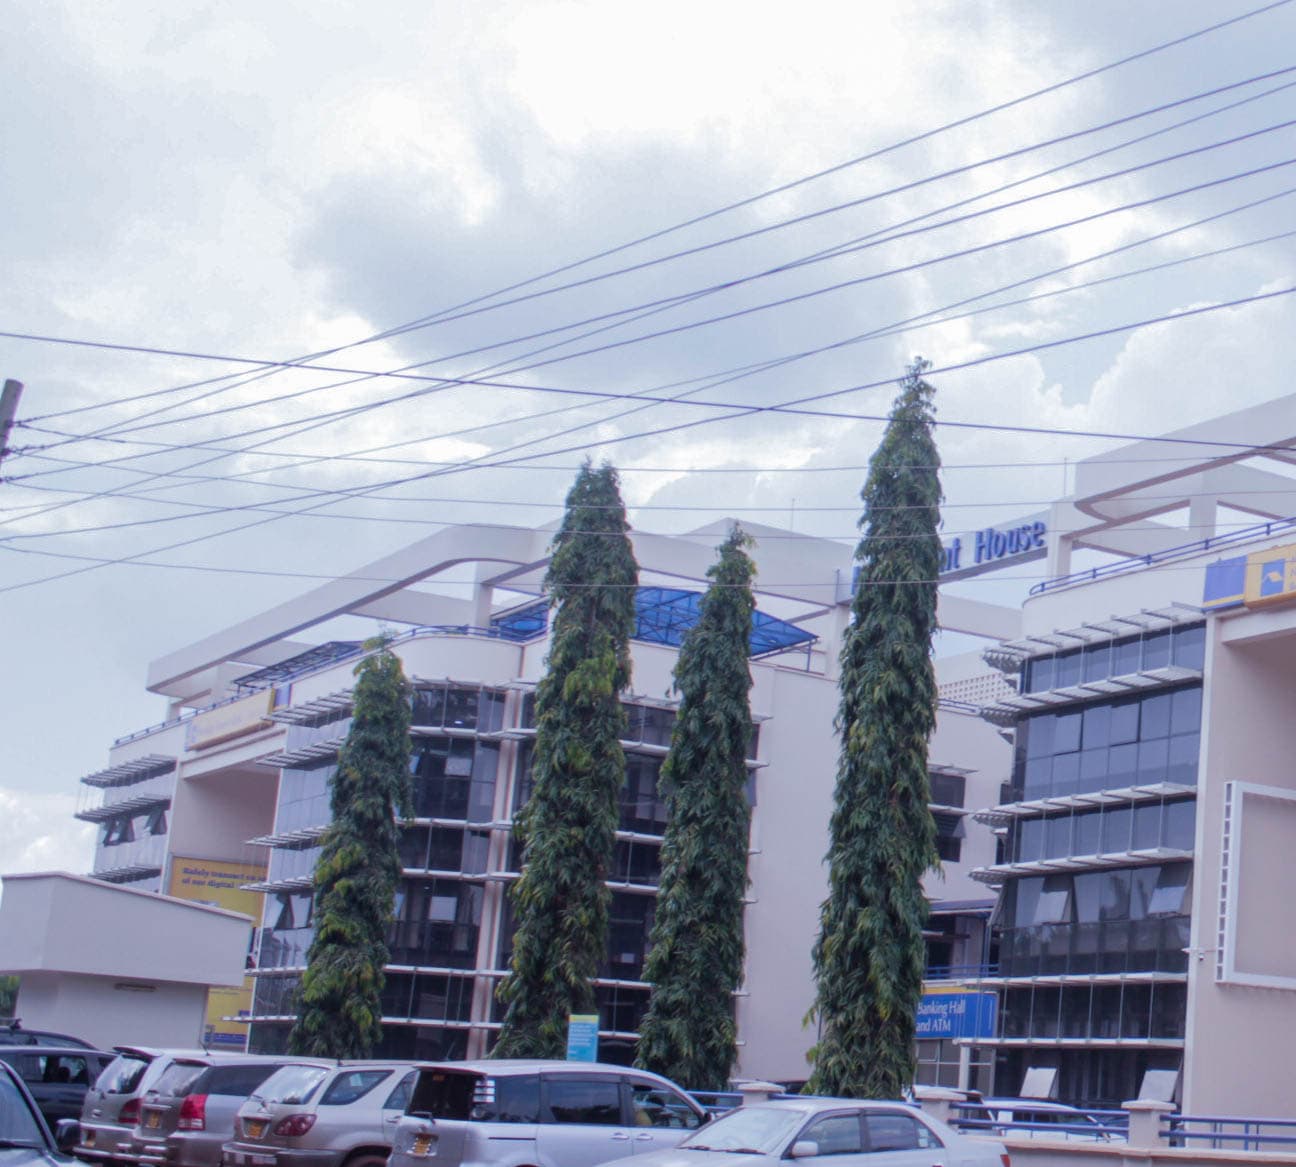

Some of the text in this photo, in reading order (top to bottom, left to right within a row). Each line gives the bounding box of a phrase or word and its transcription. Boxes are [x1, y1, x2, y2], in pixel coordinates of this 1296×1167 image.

[975, 521, 1047, 564] House
[917, 999, 966, 1018] Banking Hall
[915, 1017, 951, 1032] and ATM
